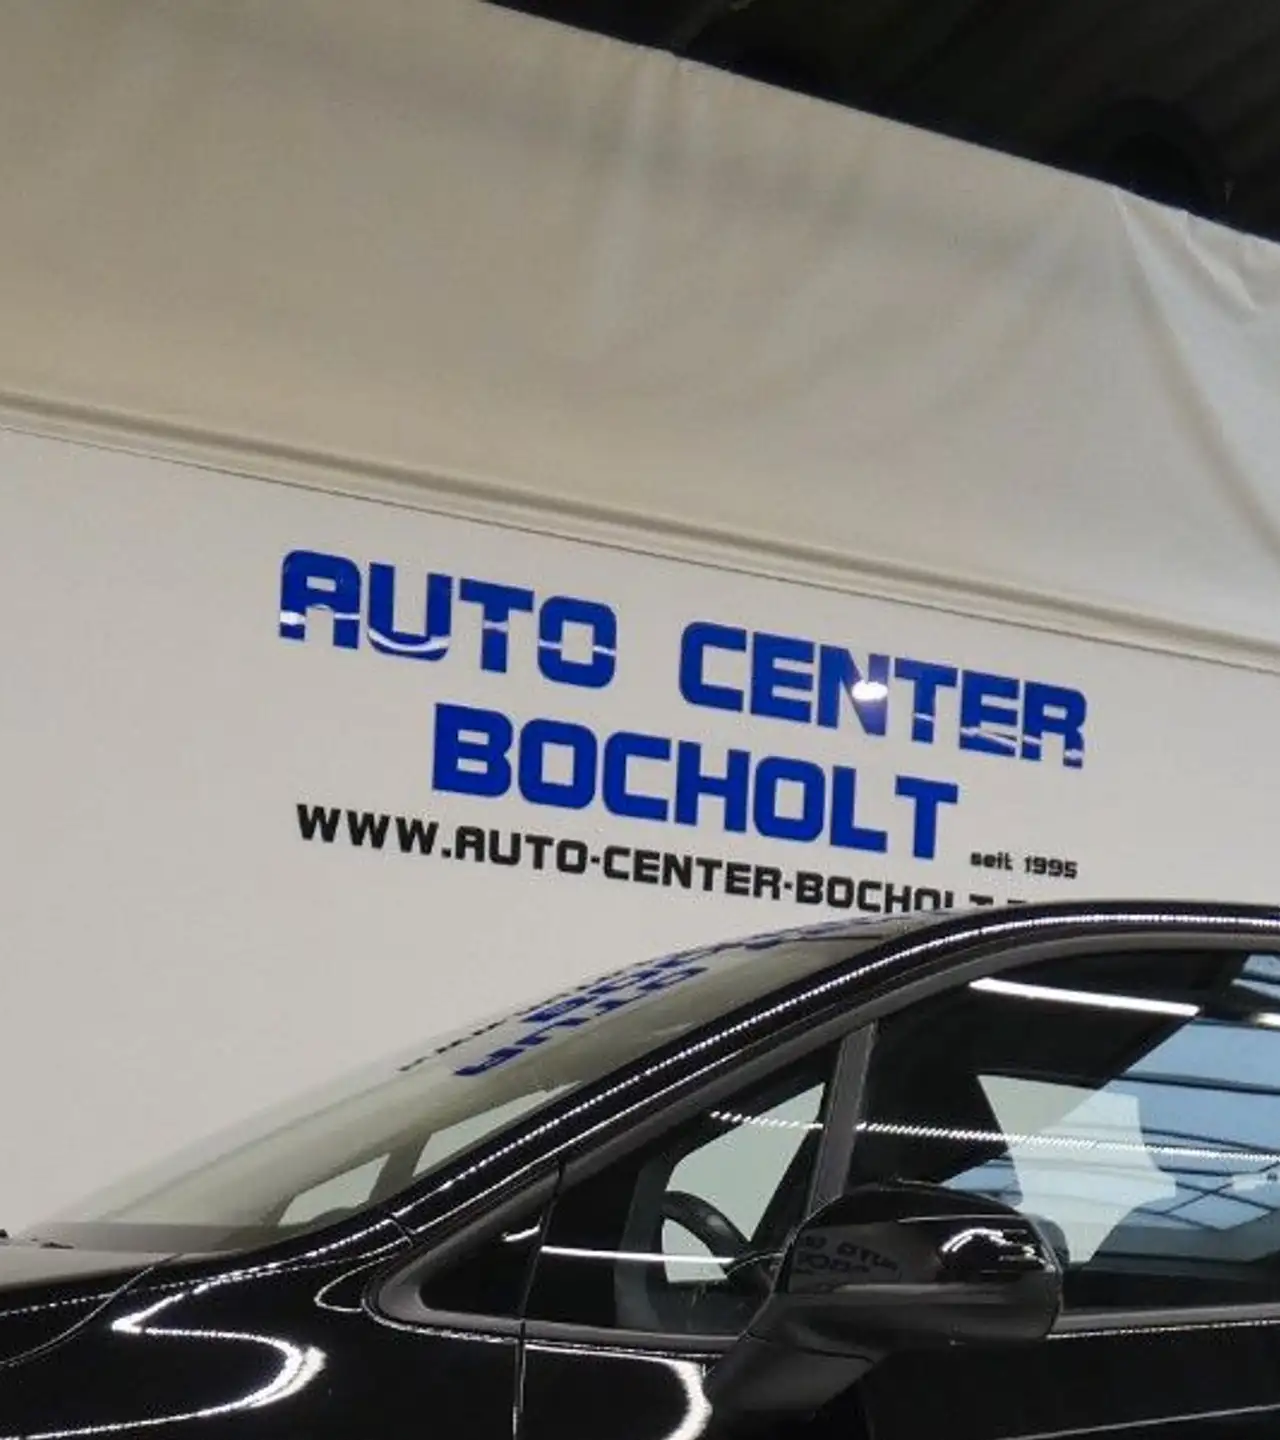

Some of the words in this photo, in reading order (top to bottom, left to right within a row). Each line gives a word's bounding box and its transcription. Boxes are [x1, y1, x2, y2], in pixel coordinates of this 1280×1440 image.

[279, 549, 618, 690] AUTO
[679, 620, 1088, 769] CENTER
[431, 702, 960, 862] BOCHOLT
[296, 803, 1028, 917] WWW.AUTO-CENTER-BOCHO
[970, 851, 1013, 871] seit
[1024, 856, 1078, 880] 1995
